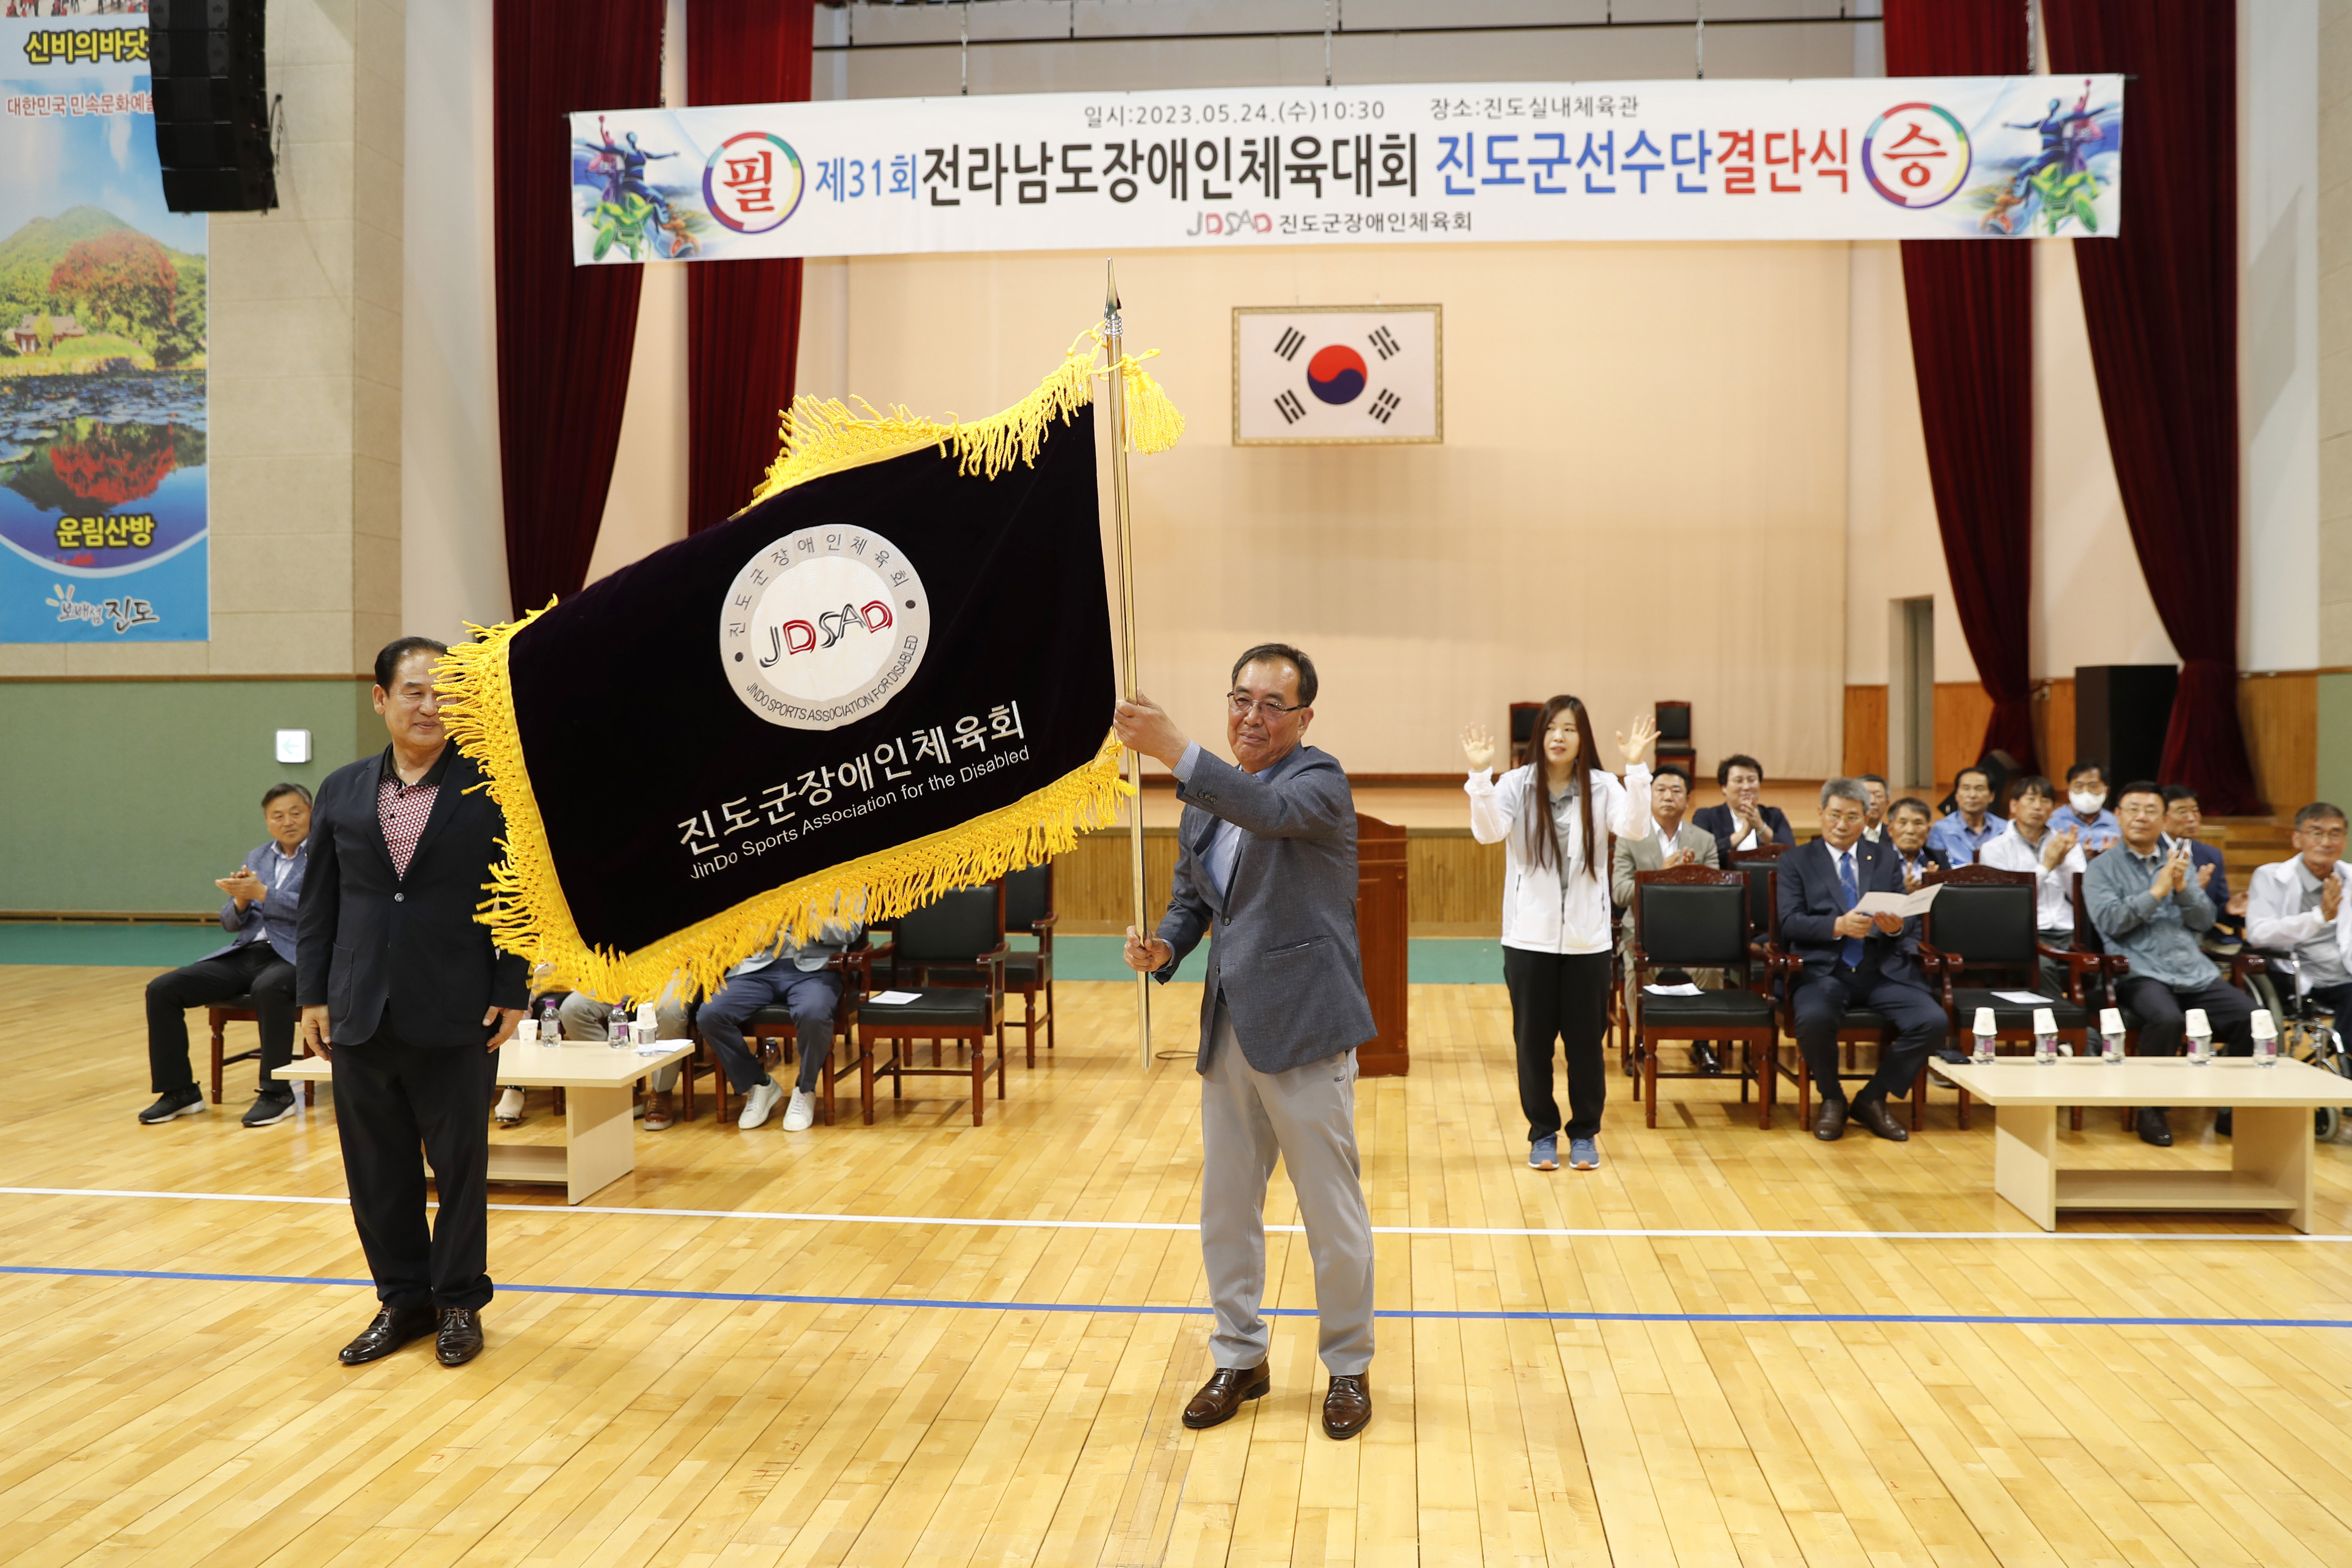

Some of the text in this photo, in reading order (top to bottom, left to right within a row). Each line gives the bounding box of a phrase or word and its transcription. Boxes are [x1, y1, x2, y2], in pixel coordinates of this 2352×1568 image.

[7, 96, 67, 117] 대한민국
[1430, 95, 1640, 120] 장소:진도실내체육관
[723, 150, 775, 213] 필
[1882, 122, 1948, 187] 승
[1278, 211, 1473, 235] 진도군장애인체육회
[55, 515, 156, 548] 운림산방
[105, 597, 159, 632] 진도
[760, 600, 893, 668] JDSAD
[747, 635, 919, 722] JINDO SPORTS ASSOCIATION FOR DISABLED
[677, 700, 1025, 855] 진도군장애인체육회
[690, 744, 1029, 879] JinDo Sports Association for the Disabled
